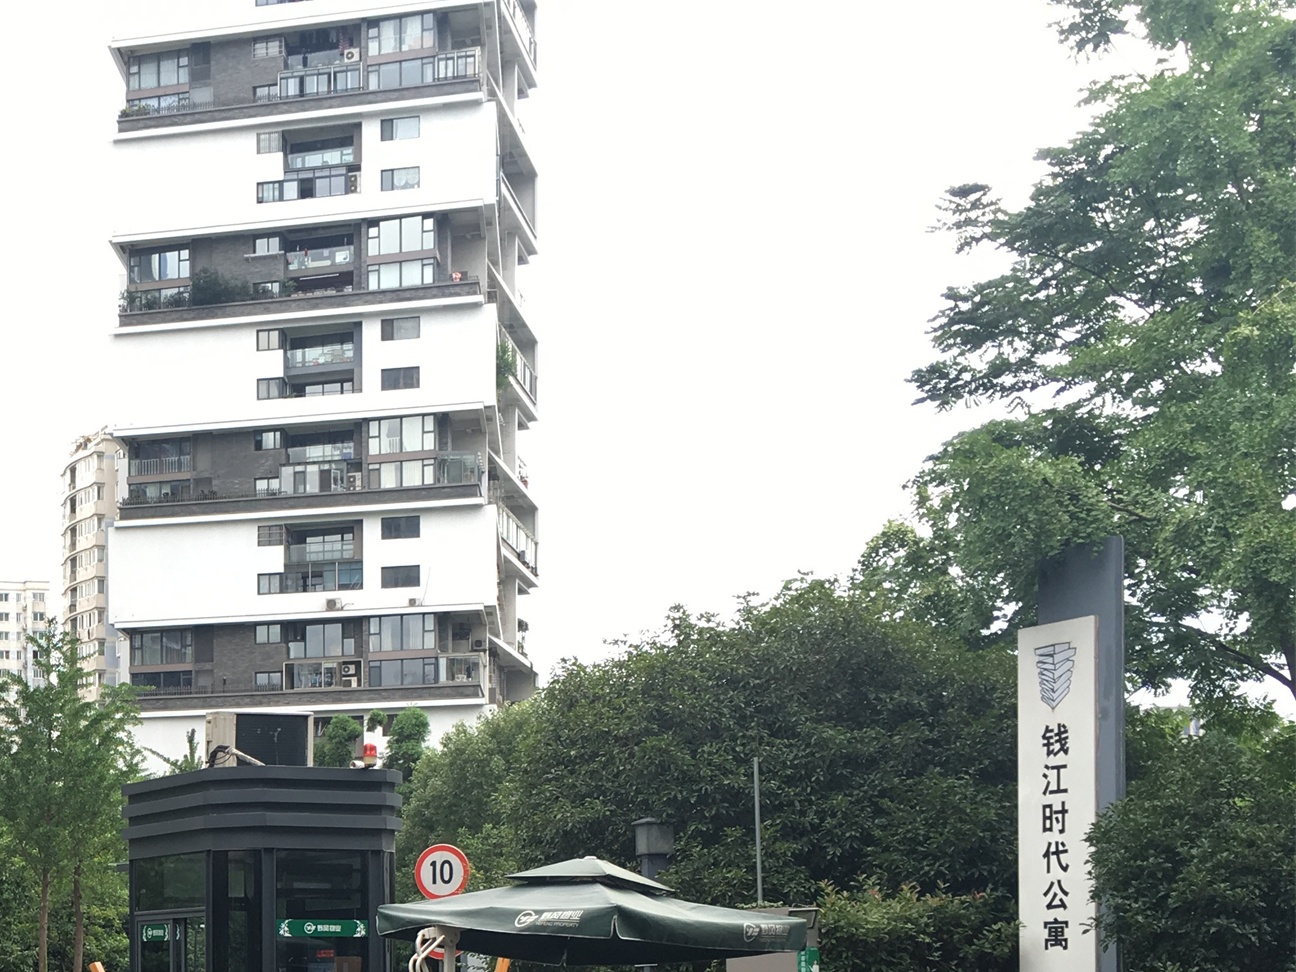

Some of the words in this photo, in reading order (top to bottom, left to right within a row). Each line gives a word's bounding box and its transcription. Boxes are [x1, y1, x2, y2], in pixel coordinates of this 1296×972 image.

[430, 860, 453, 885] 10
[1041, 723, 1070, 951] 钱江时代公寓
